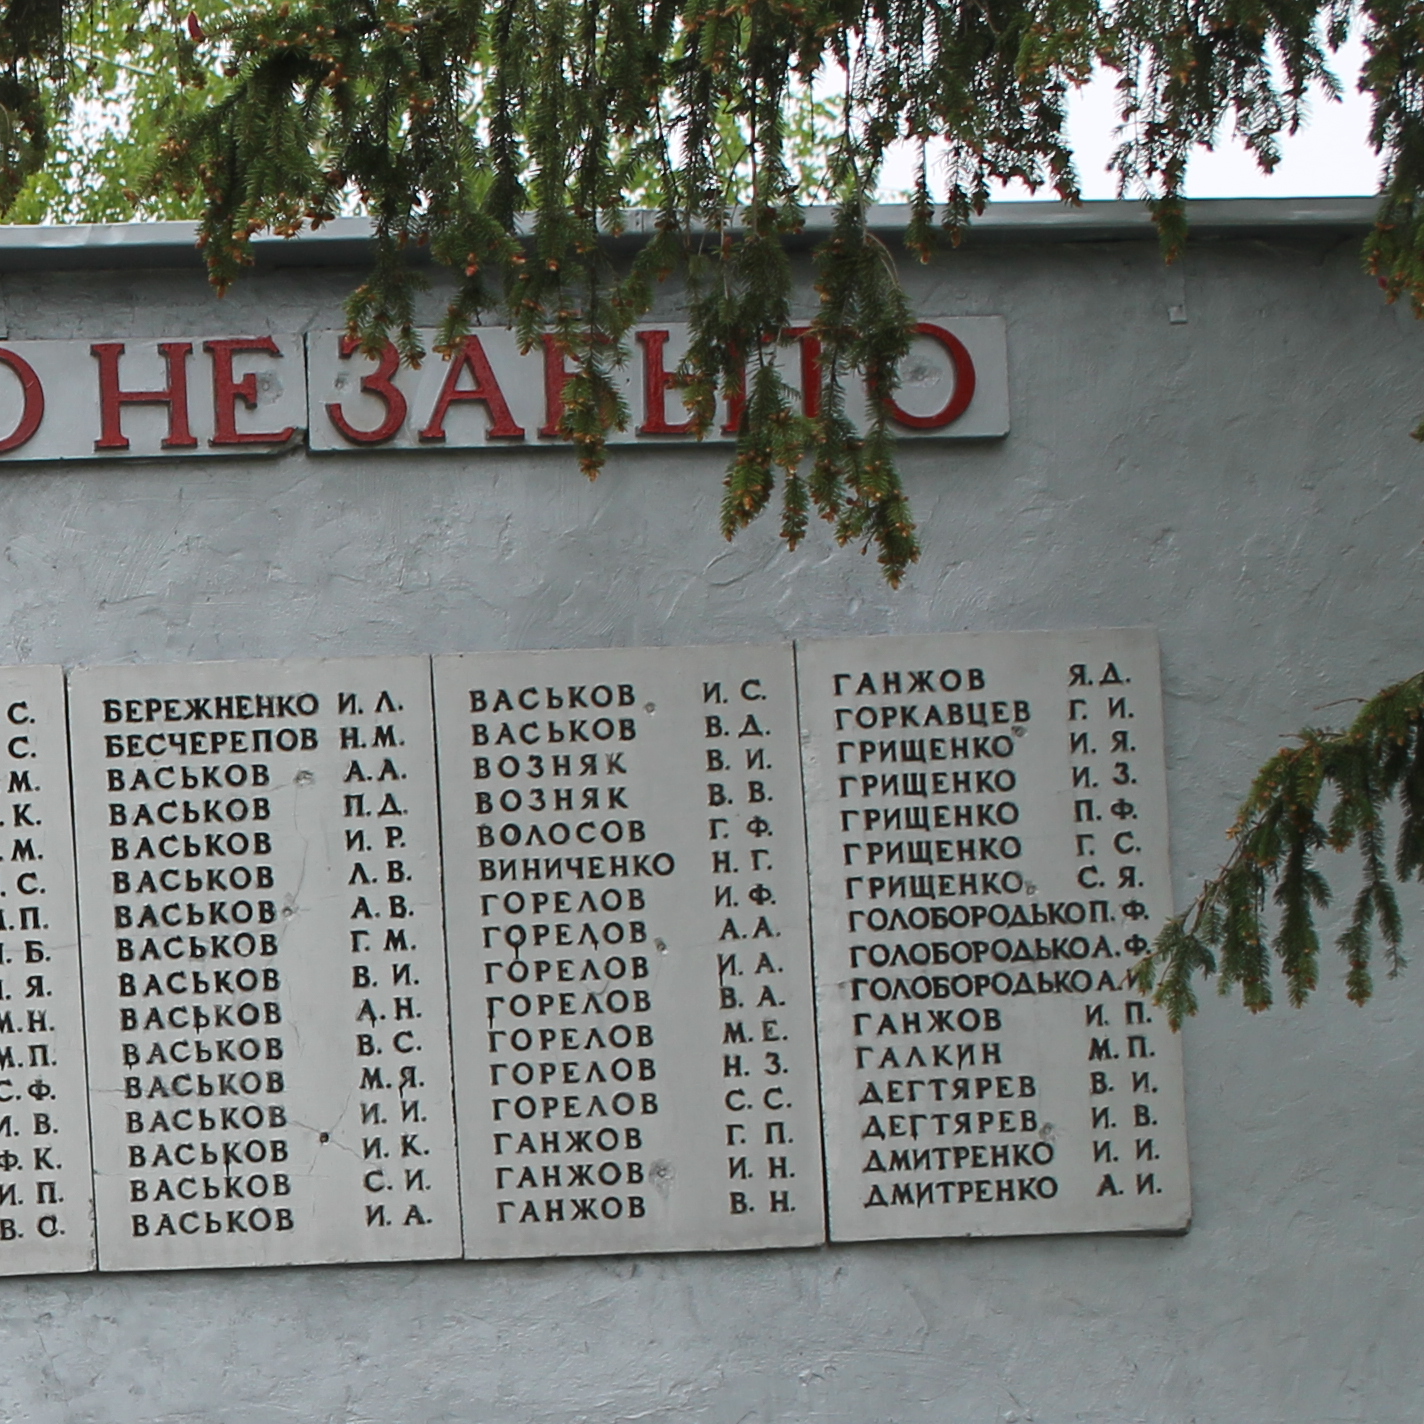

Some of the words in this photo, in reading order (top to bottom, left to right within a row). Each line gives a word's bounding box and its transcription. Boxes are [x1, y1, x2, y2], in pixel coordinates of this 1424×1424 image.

[93, 337, 294, 446] НЕ
[834, 668, 985, 696] ГАНЖОВ
[102, 693, 319, 723] БЕРЕЖНЕНКО
[469, 684, 635, 713] ВАСЬКОВ
[835, 700, 1030, 730] ГОРКАВЦЕВ
[104, 728, 318, 758] БЕСЧЕРЕПОВ
[472, 718, 636, 746] ВАСЬКОВ
[837, 735, 1013, 764] ГРИЩЕНКО
[107, 764, 269, 792] ВАСЬКОВ
[473, 753, 626, 779] ВОЗНЯК
[109, 798, 270, 826] ВАСЬКОВ
[475, 787, 628, 814] ВОЗНЯК
[477, 820, 645, 847] ВОЛОСОВ
[479, 853, 675, 881] ВИНИЧЕНКО
[846, 871, 1023, 899] ГРИЩЕНКО
[114, 900, 276, 930] ВАСЬКОВ
[481, 889, 645, 916] ГОРЕЛОВ
[849, 901, 1088, 932] ГОЛОБОРОДЬКО
[483, 921, 646, 953] ГОРЕЛОВ
[849, 937, 1091, 968] ГОЛОБОРОДЬКО
[850, 970, 1092, 1001] ГОЛОБОРОДЬКО
[120, 1002, 281, 1032] ВАСЬКОВ
[486, 990, 651, 1022] ГОРЕЛОВ
[853, 1008, 1001, 1036] ГАНЖОВ
[855, 1043, 1001, 1070] ГАЛКИН
[859, 1076, 1036, 1105] ДЕГТЯРЕВ
[126, 1106, 287, 1133] ВАСЬКОВ
[492, 1092, 658, 1121] ГОРЕЛОВ
[861, 1110, 1037, 1140] ДЕГТЯРЕВ
[494, 1128, 642, 1155] ГАНЖОВ
[862, 1142, 1054, 1173] ДМИТРЕНКО
[496, 1162, 643, 1189] ГАНЖОВ
[864, 1176, 1058, 1208] ДМИТРЕНКО
[132, 1208, 294, 1237] ВАСЬКОВ
[497, 1196, 645, 1223] ГАНЖОВ
